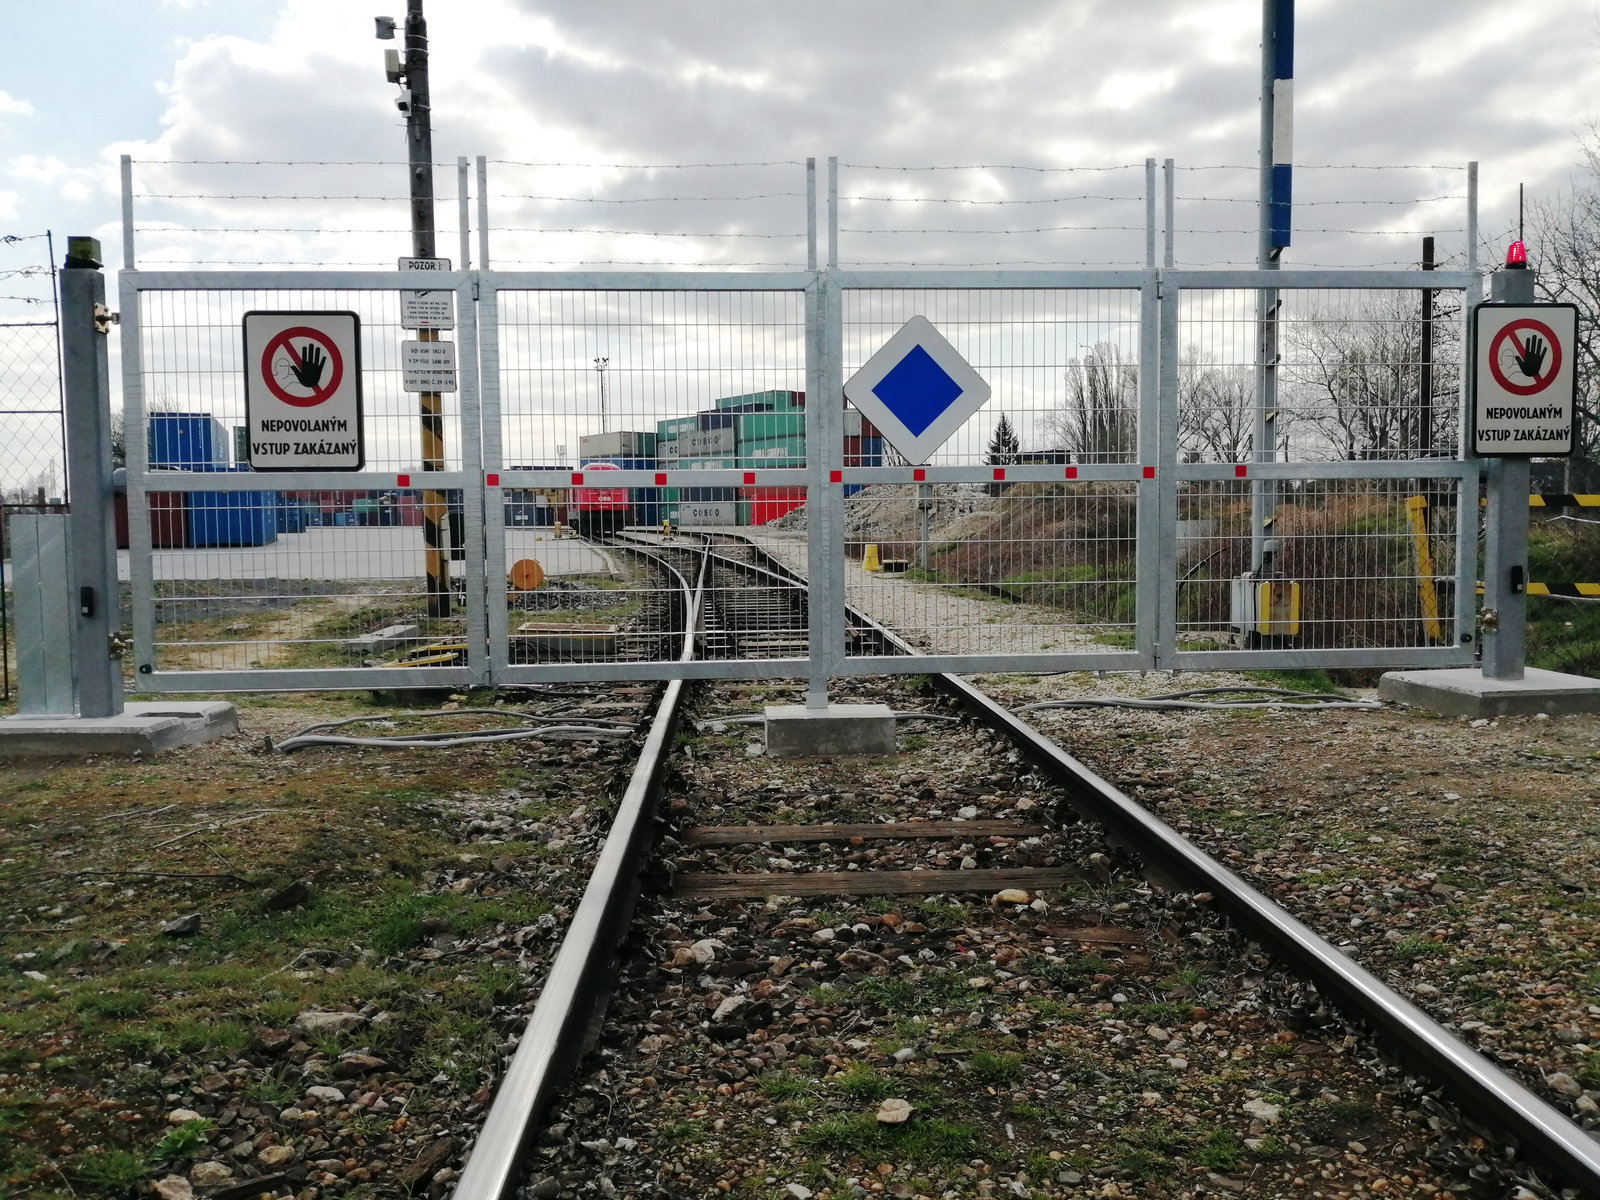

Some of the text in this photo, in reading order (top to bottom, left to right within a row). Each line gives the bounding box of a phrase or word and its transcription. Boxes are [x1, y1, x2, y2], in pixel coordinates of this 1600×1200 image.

[409, 261, 436, 270] POZOR
[1486, 404, 1562, 420] NEPOVOLANÝM
[261, 416, 347, 432] NEPOVOLANÝM
[1478, 425, 1570, 441] VSTUP ZAKÁZANÝ
[252, 439, 357, 455] VSTUP ZAKÁZANÝ
